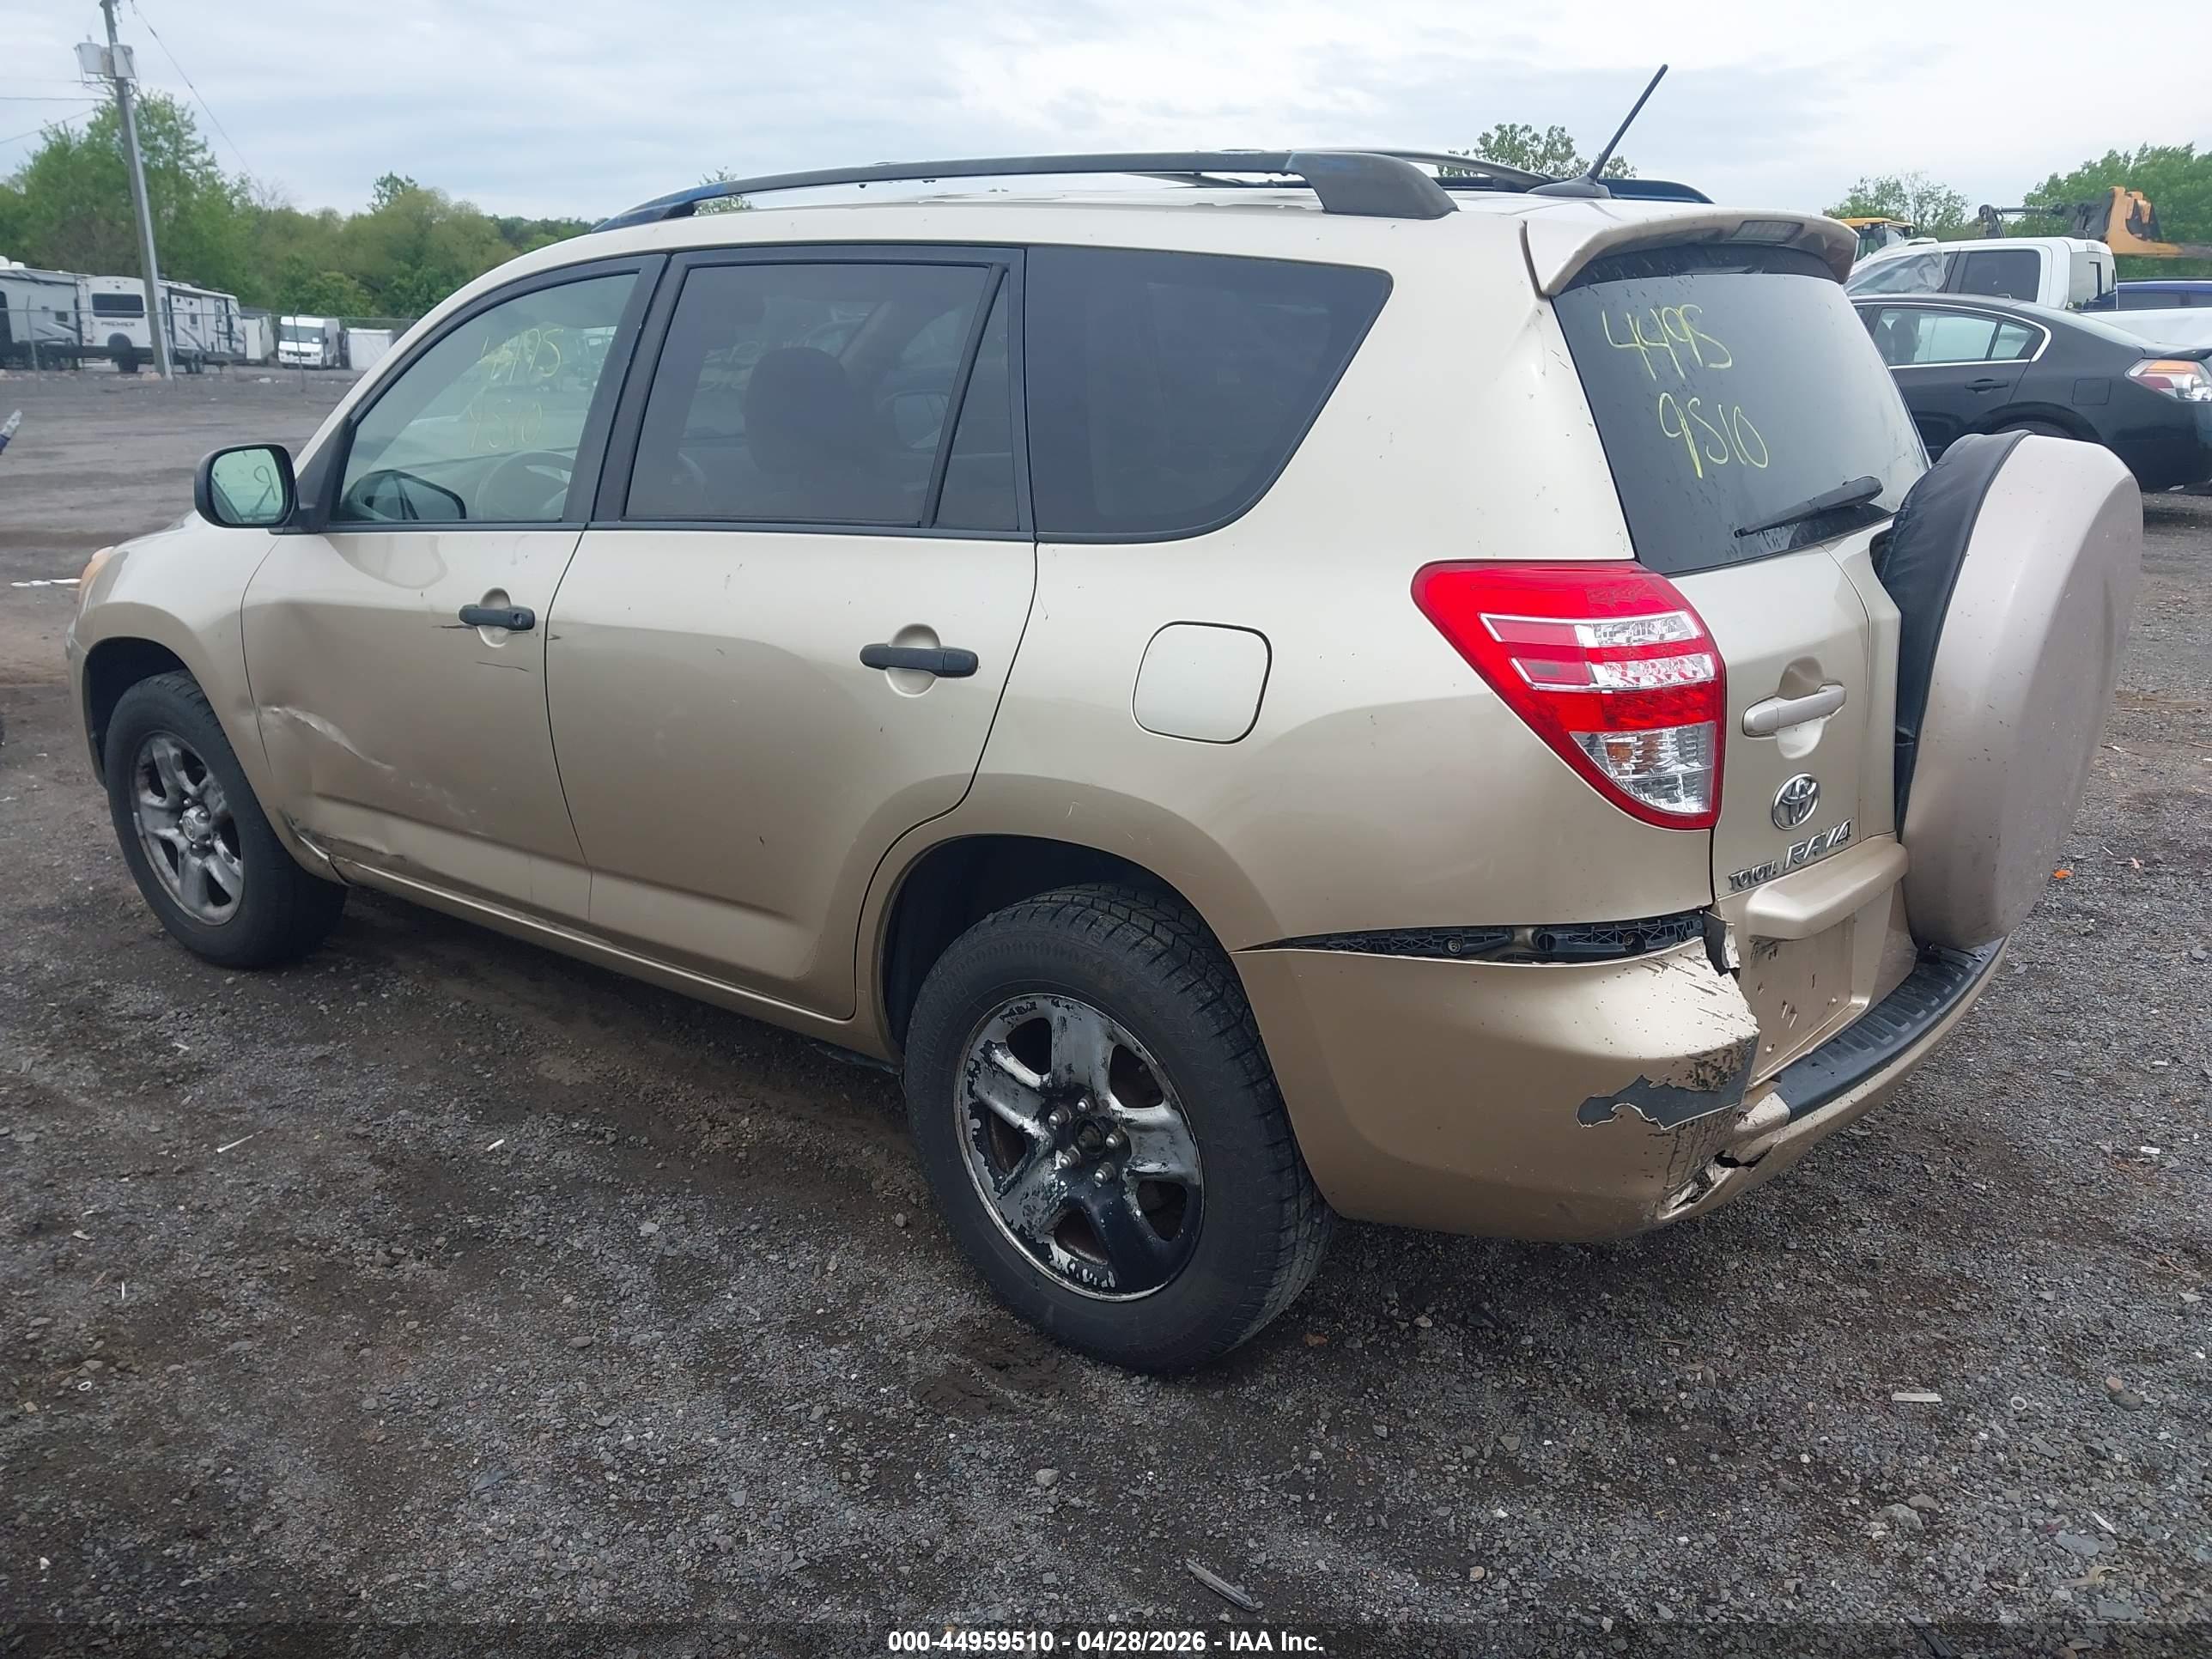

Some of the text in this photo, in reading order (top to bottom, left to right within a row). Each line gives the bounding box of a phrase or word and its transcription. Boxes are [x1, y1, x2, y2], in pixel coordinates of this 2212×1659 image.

[1601, 304, 1733, 380] 4495
[1657, 392, 1770, 479] 9510
[1728, 817, 1852, 891] TOYOTA RAV4
